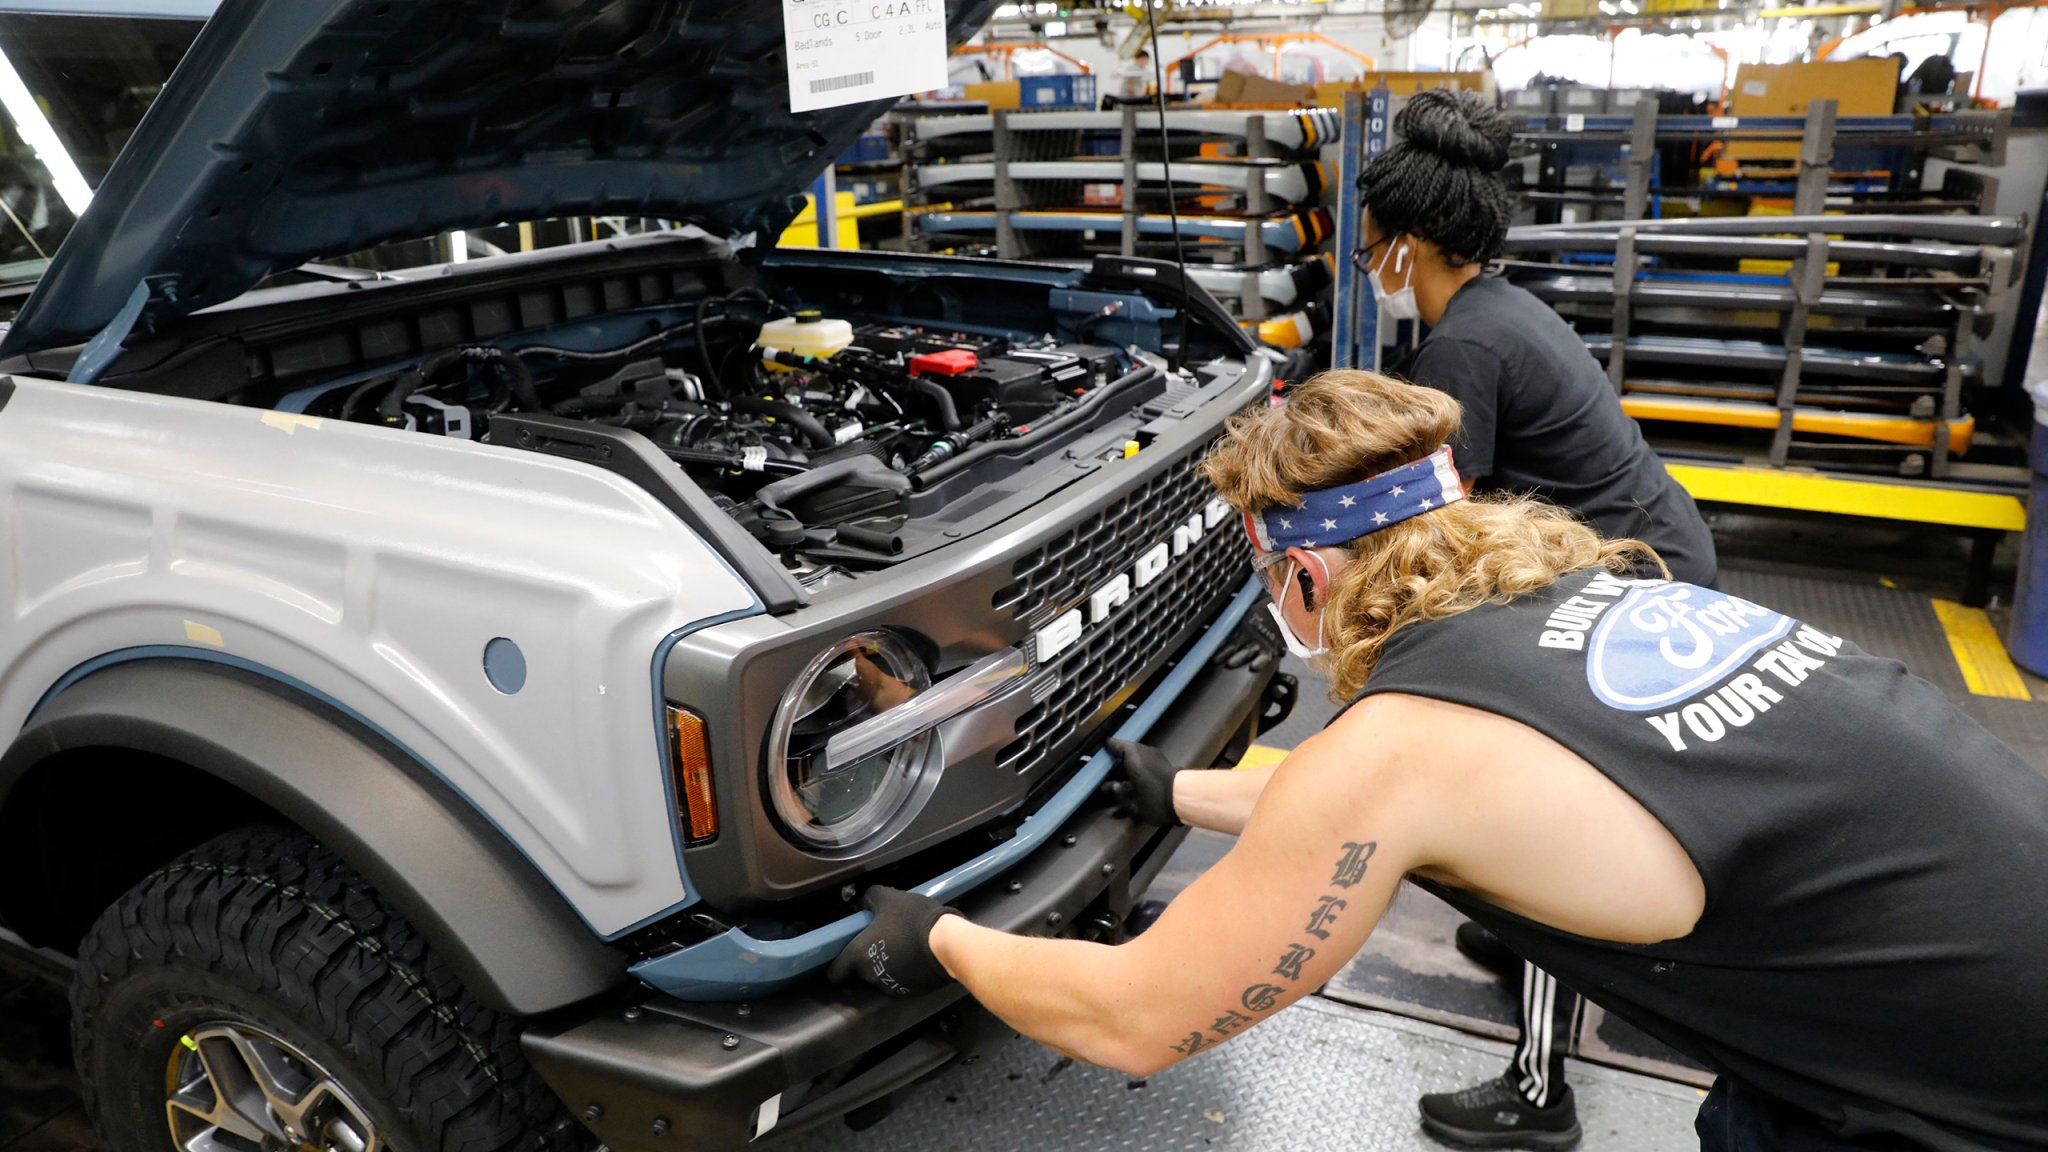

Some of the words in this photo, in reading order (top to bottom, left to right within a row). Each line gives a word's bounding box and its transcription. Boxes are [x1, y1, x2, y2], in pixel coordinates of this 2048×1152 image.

[794, 36, 833, 51] Badlands
[855, 31, 861, 42] 5
[864, 30, 882, 41] Door
[814, 13, 830, 28] CG
[836, 10, 848, 25] C
[886, 3, 894, 17] 4
[899, 1, 911, 16] A
[1538, 595, 1611, 651] BUILT
[1629, 588, 1773, 669] Ford
[1645, 672, 1784, 752] YOUR
[1169, 840, 1377, 1057] BERGEN
